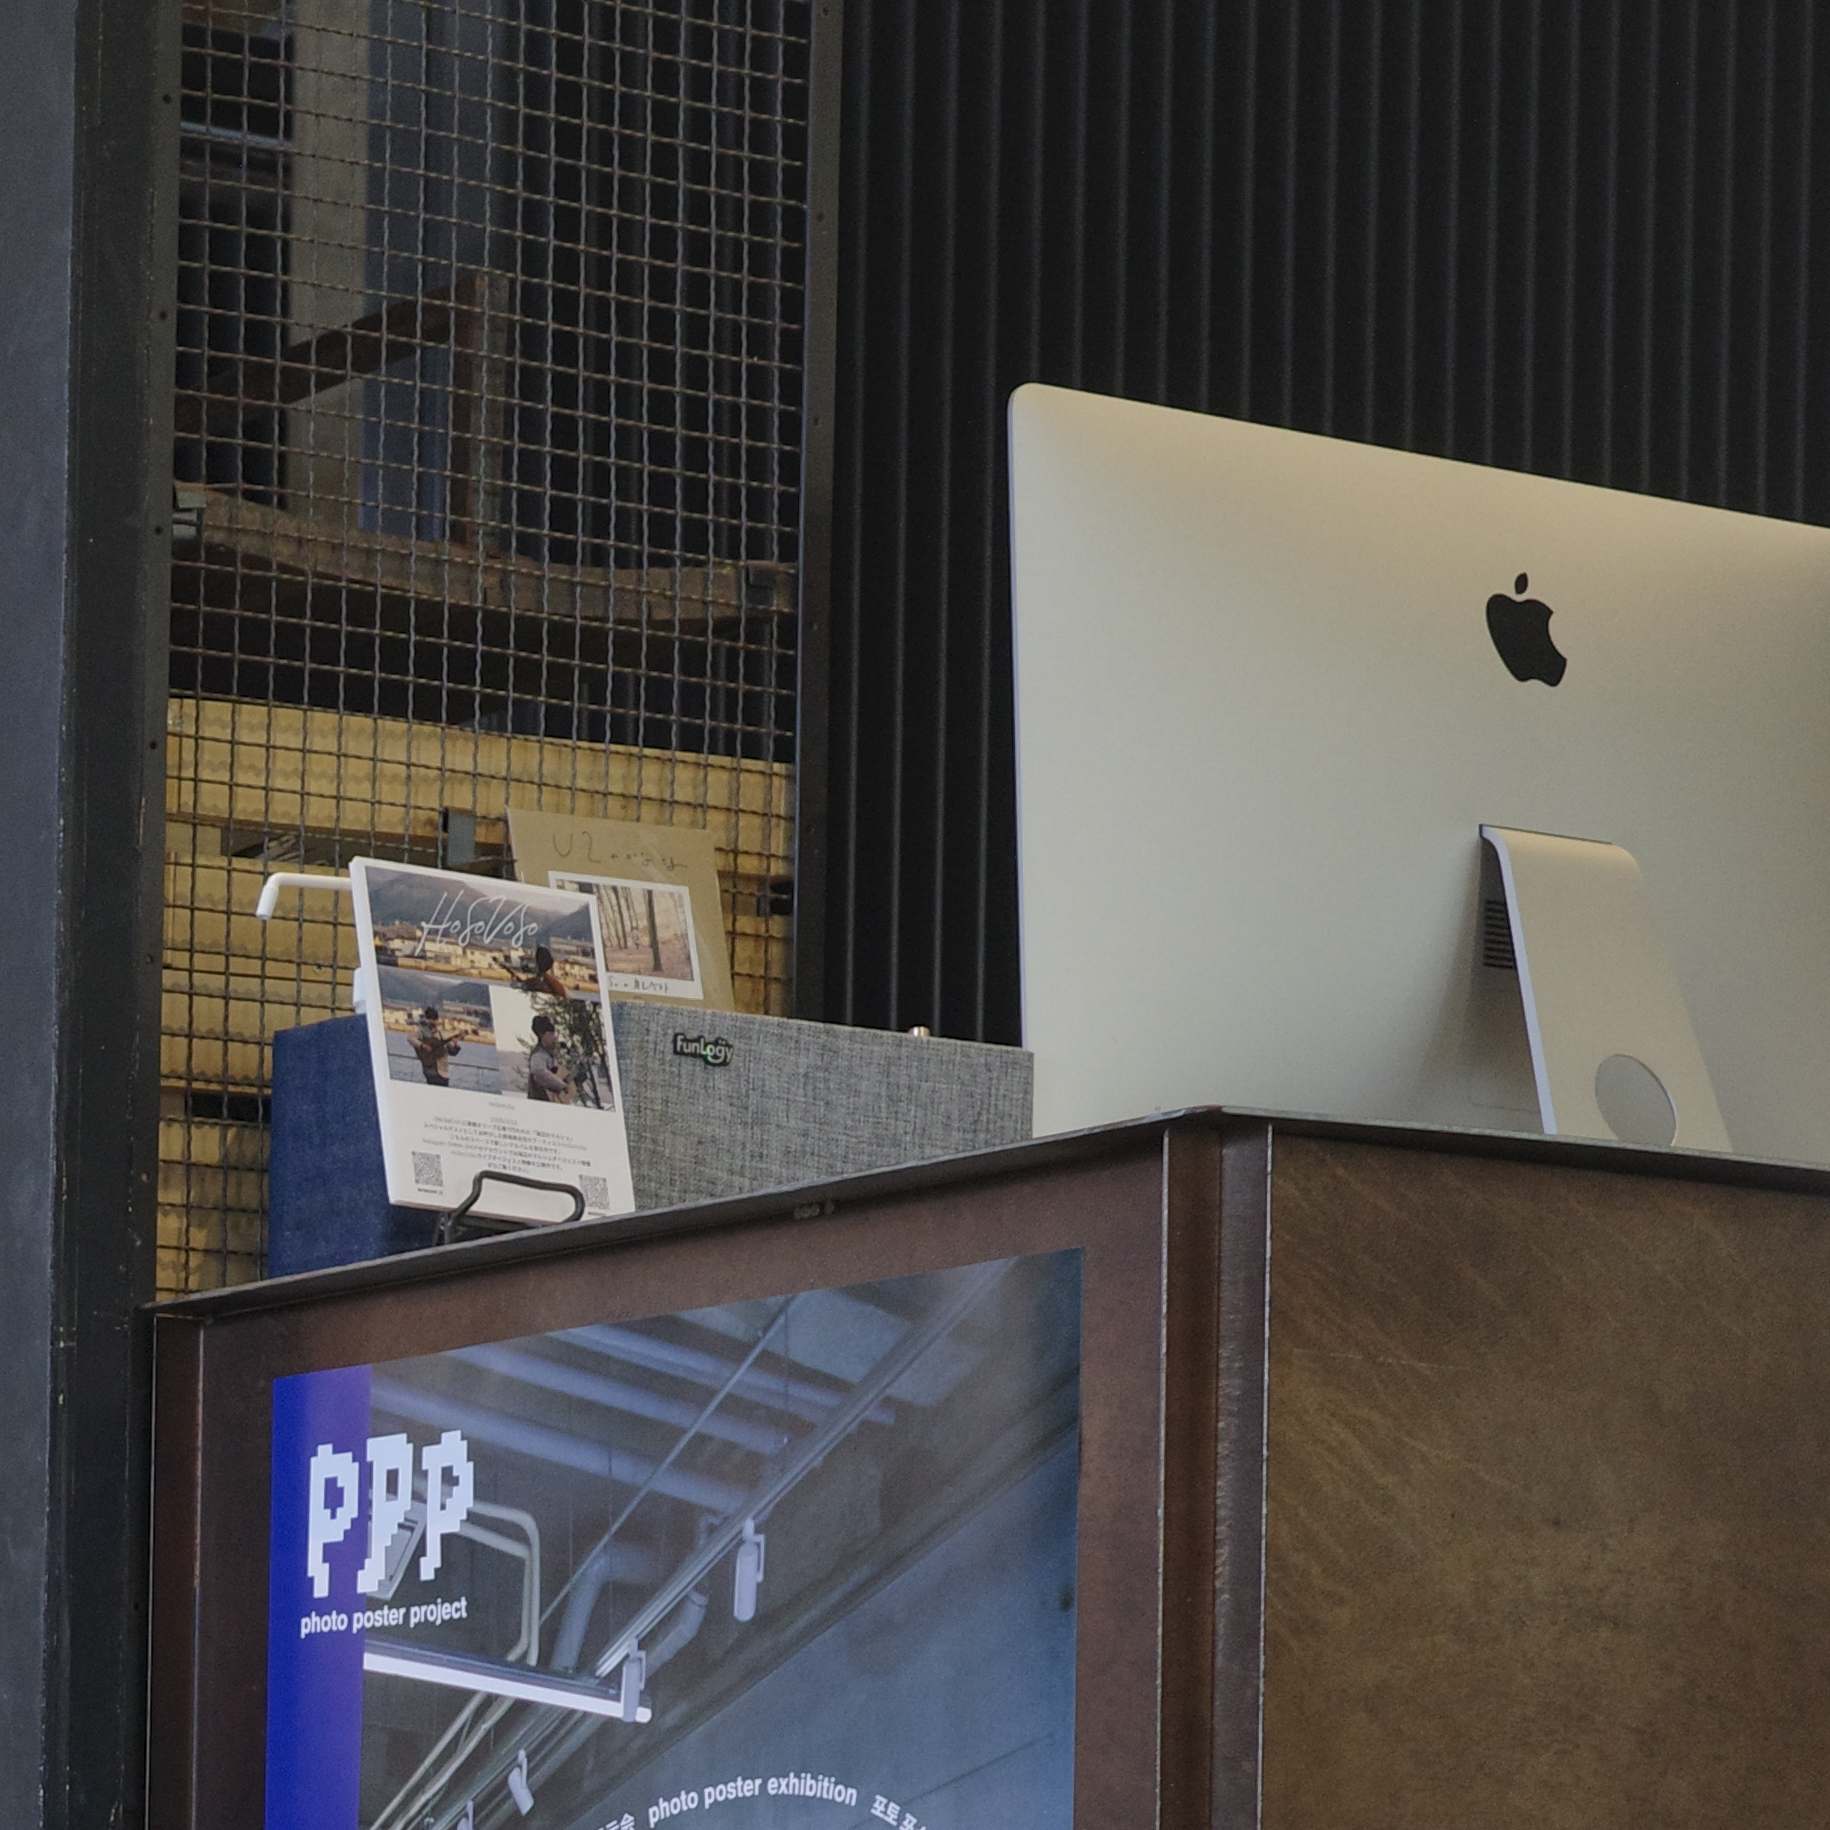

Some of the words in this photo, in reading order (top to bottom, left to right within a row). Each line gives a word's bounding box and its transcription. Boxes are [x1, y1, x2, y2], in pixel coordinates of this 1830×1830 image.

[300, 1609, 348, 1639] photo
[352, 1604, 406, 1634] poster
[409, 1596, 468, 1628] project
[647, 1788, 699, 1829] photo
[704, 1775, 762, 1809] poster
[767, 1771, 858, 1807] exhibition
[870, 1794, 901, 1826] 포토
